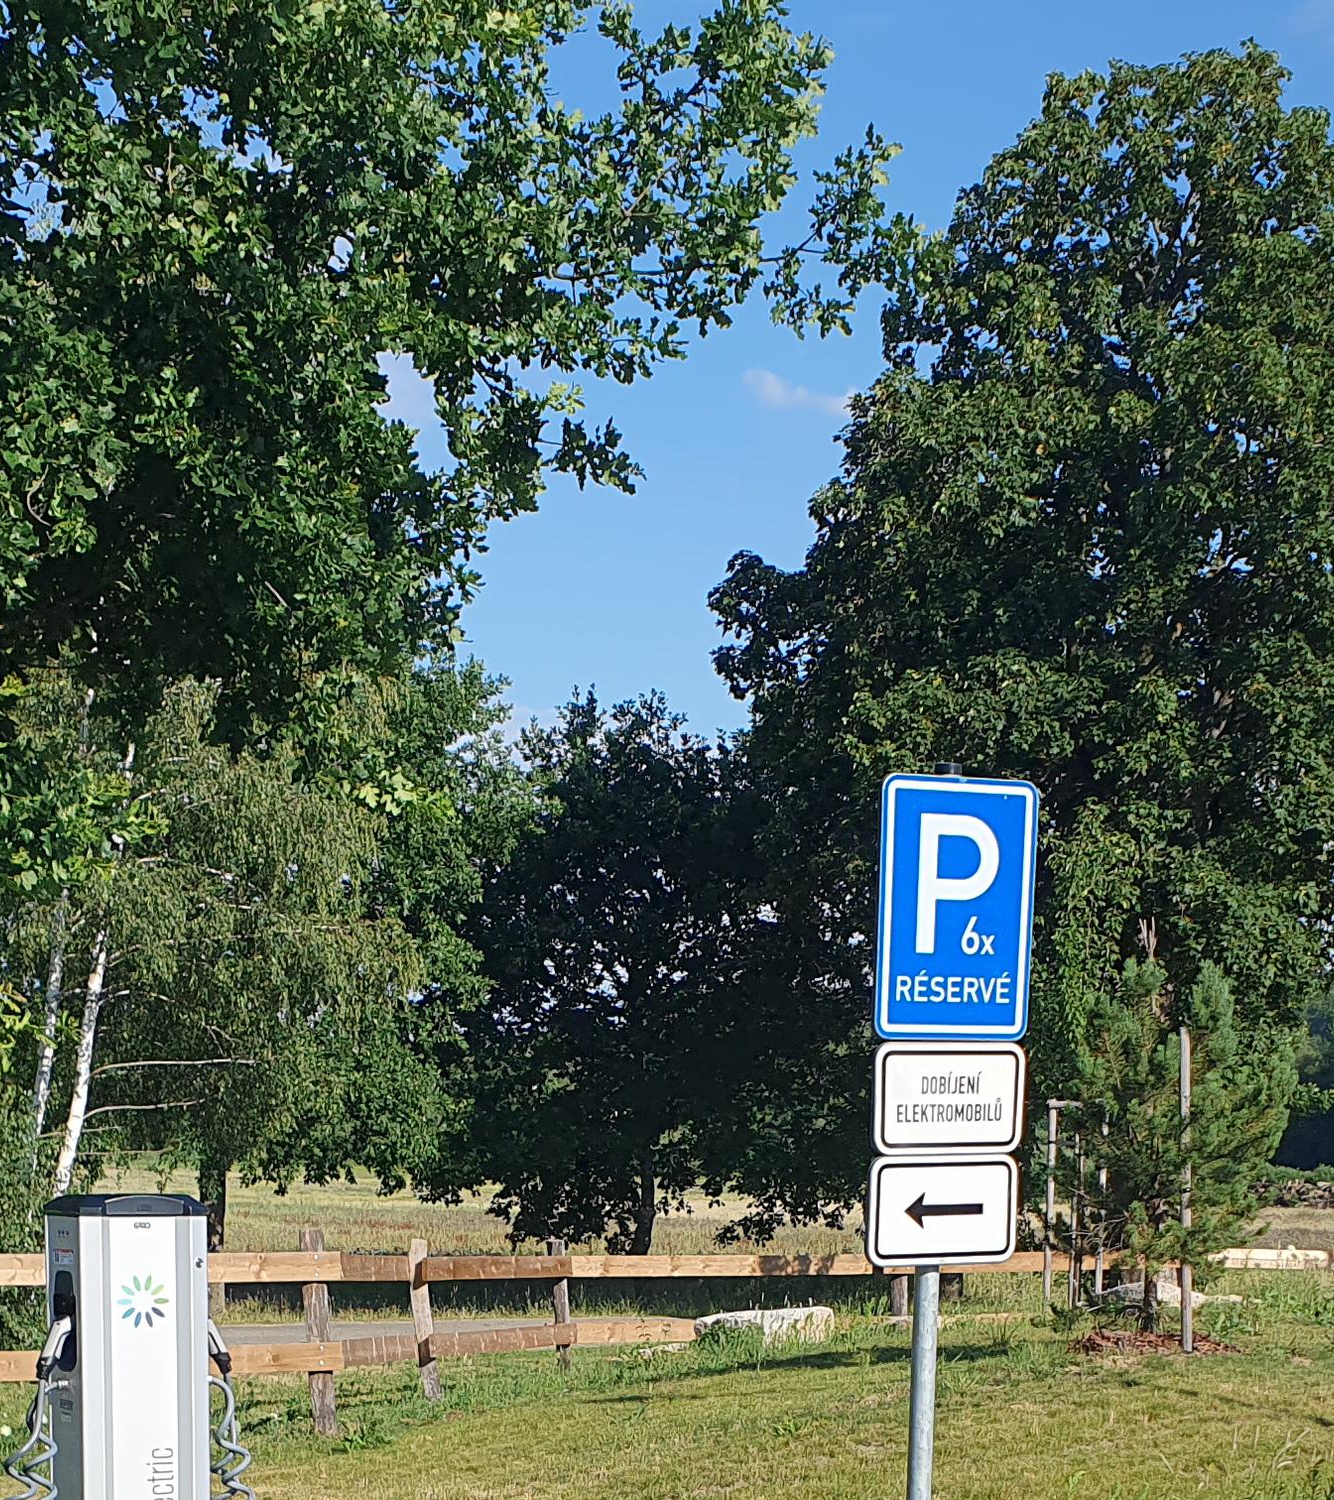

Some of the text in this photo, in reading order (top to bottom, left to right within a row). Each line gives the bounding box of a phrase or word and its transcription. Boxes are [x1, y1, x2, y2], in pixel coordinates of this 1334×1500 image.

[915, 812, 1000, 954] P
[961, 915, 995, 955] 6x
[895, 969, 1011, 1004] RÉSERVÉ
[921, 1071, 982, 1095] DOBÍJENÍ
[896, 1097, 1002, 1123] ELEKTROMOBILŮ
